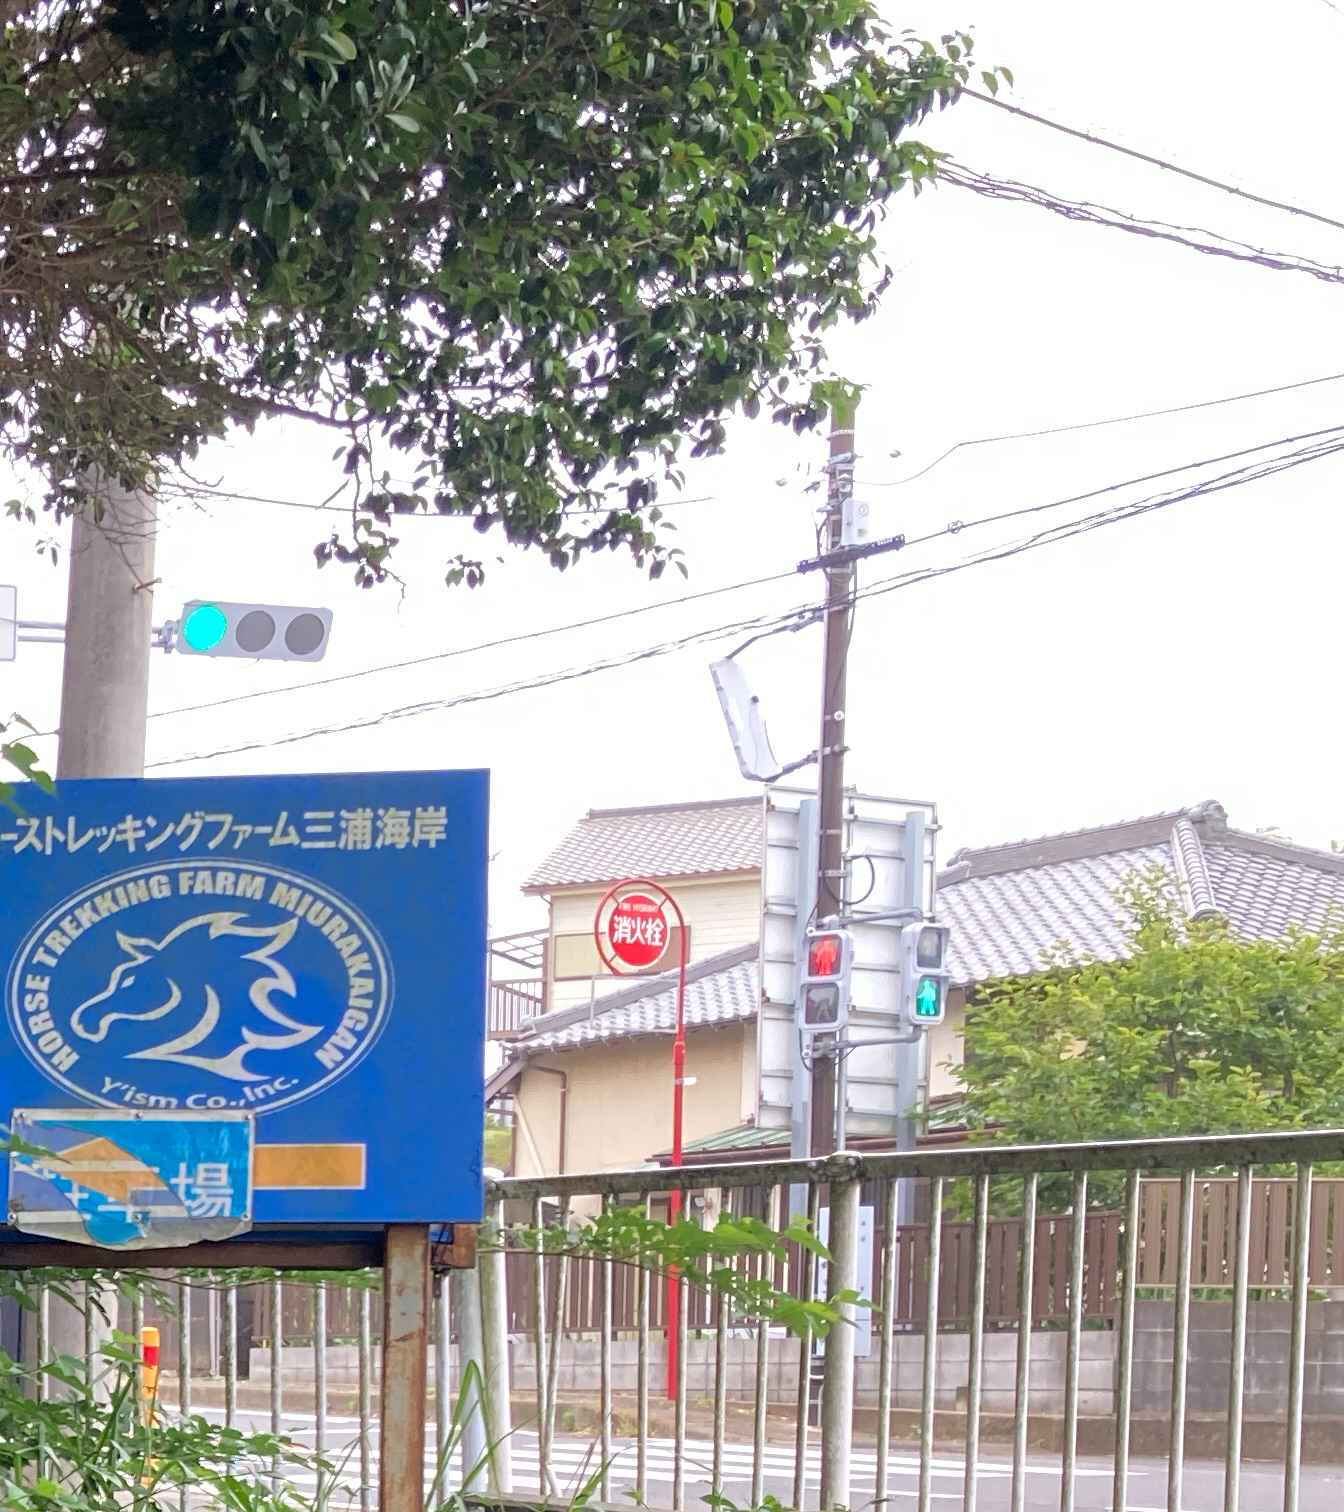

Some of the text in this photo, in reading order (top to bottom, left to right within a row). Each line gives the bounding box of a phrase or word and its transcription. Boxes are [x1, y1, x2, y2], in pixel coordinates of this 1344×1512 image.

[612, 914, 665, 947] 消火栓
[24, 870, 376, 1074] HORSE TREKKING FARM MIURAKAIGAN
[101, 1076, 178, 1109] Y'ism
